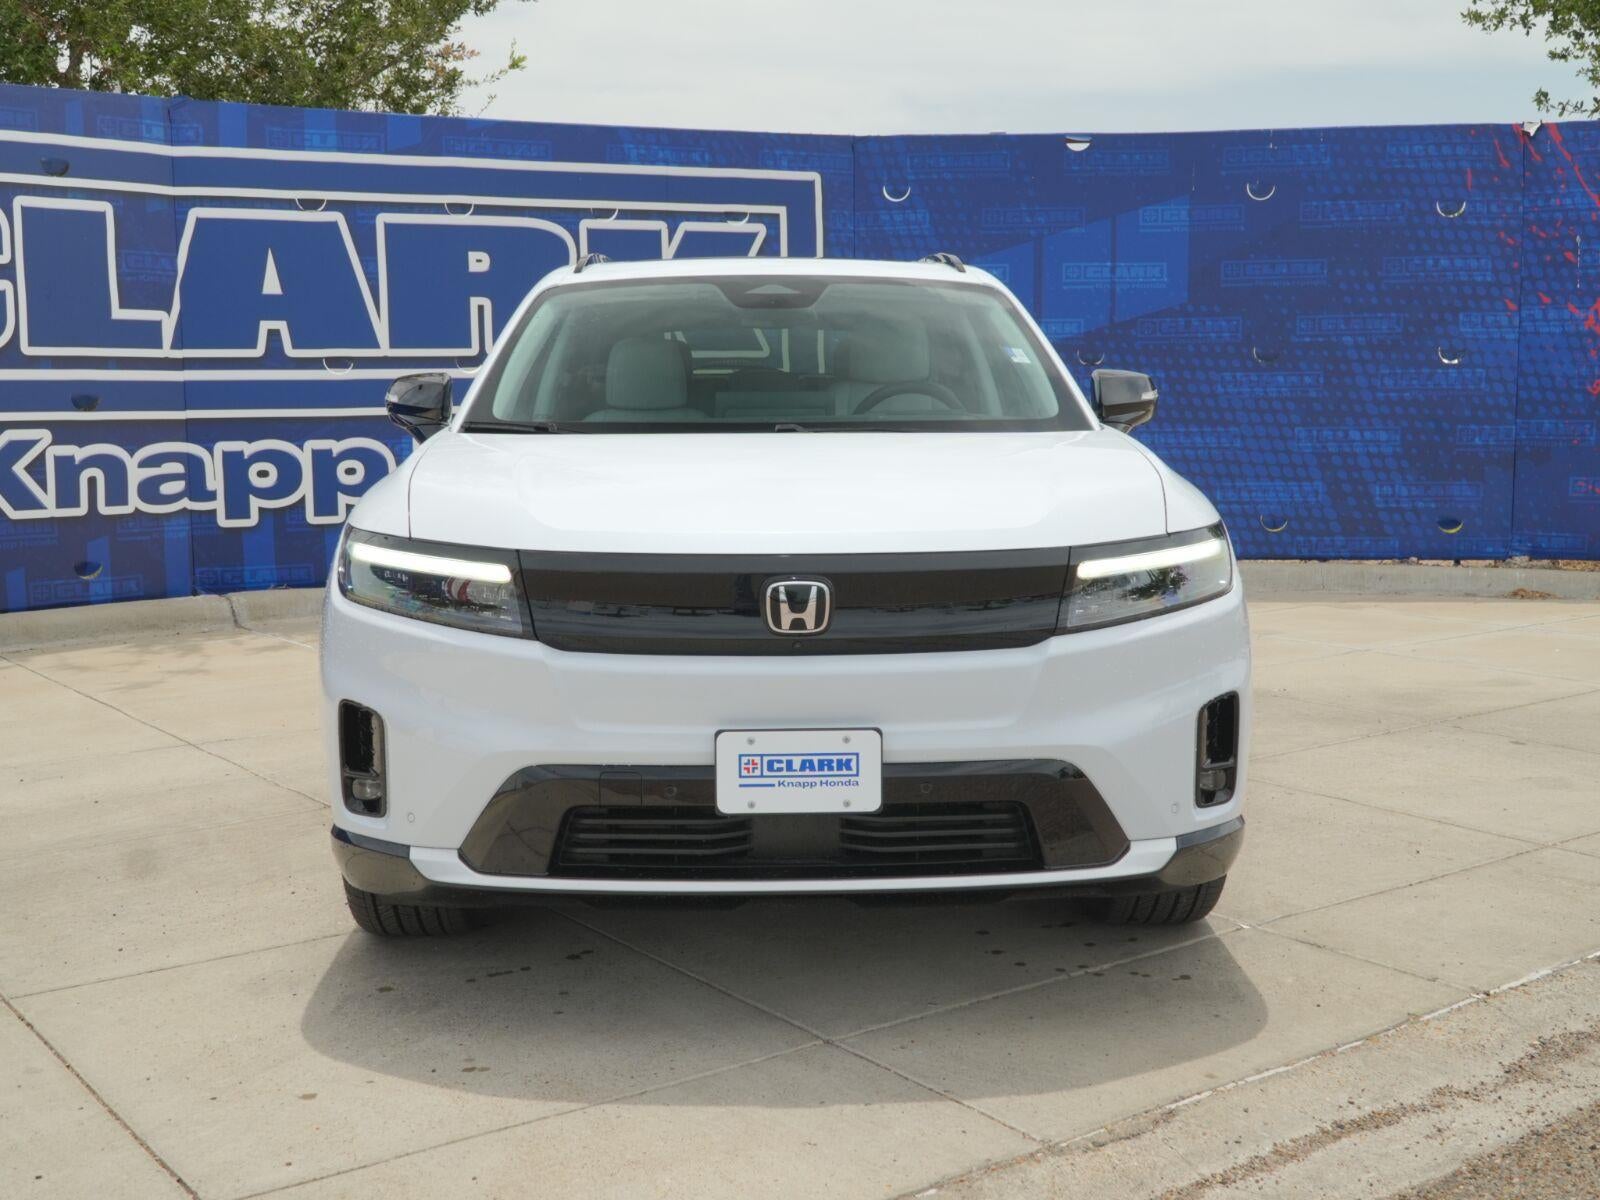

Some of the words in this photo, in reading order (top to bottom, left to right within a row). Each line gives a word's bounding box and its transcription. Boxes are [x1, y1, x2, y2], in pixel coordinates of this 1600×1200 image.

[766, 758, 853, 772] CLARK
[778, 779, 817, 789] Knapp
[819, 778, 859, 787] Honda
